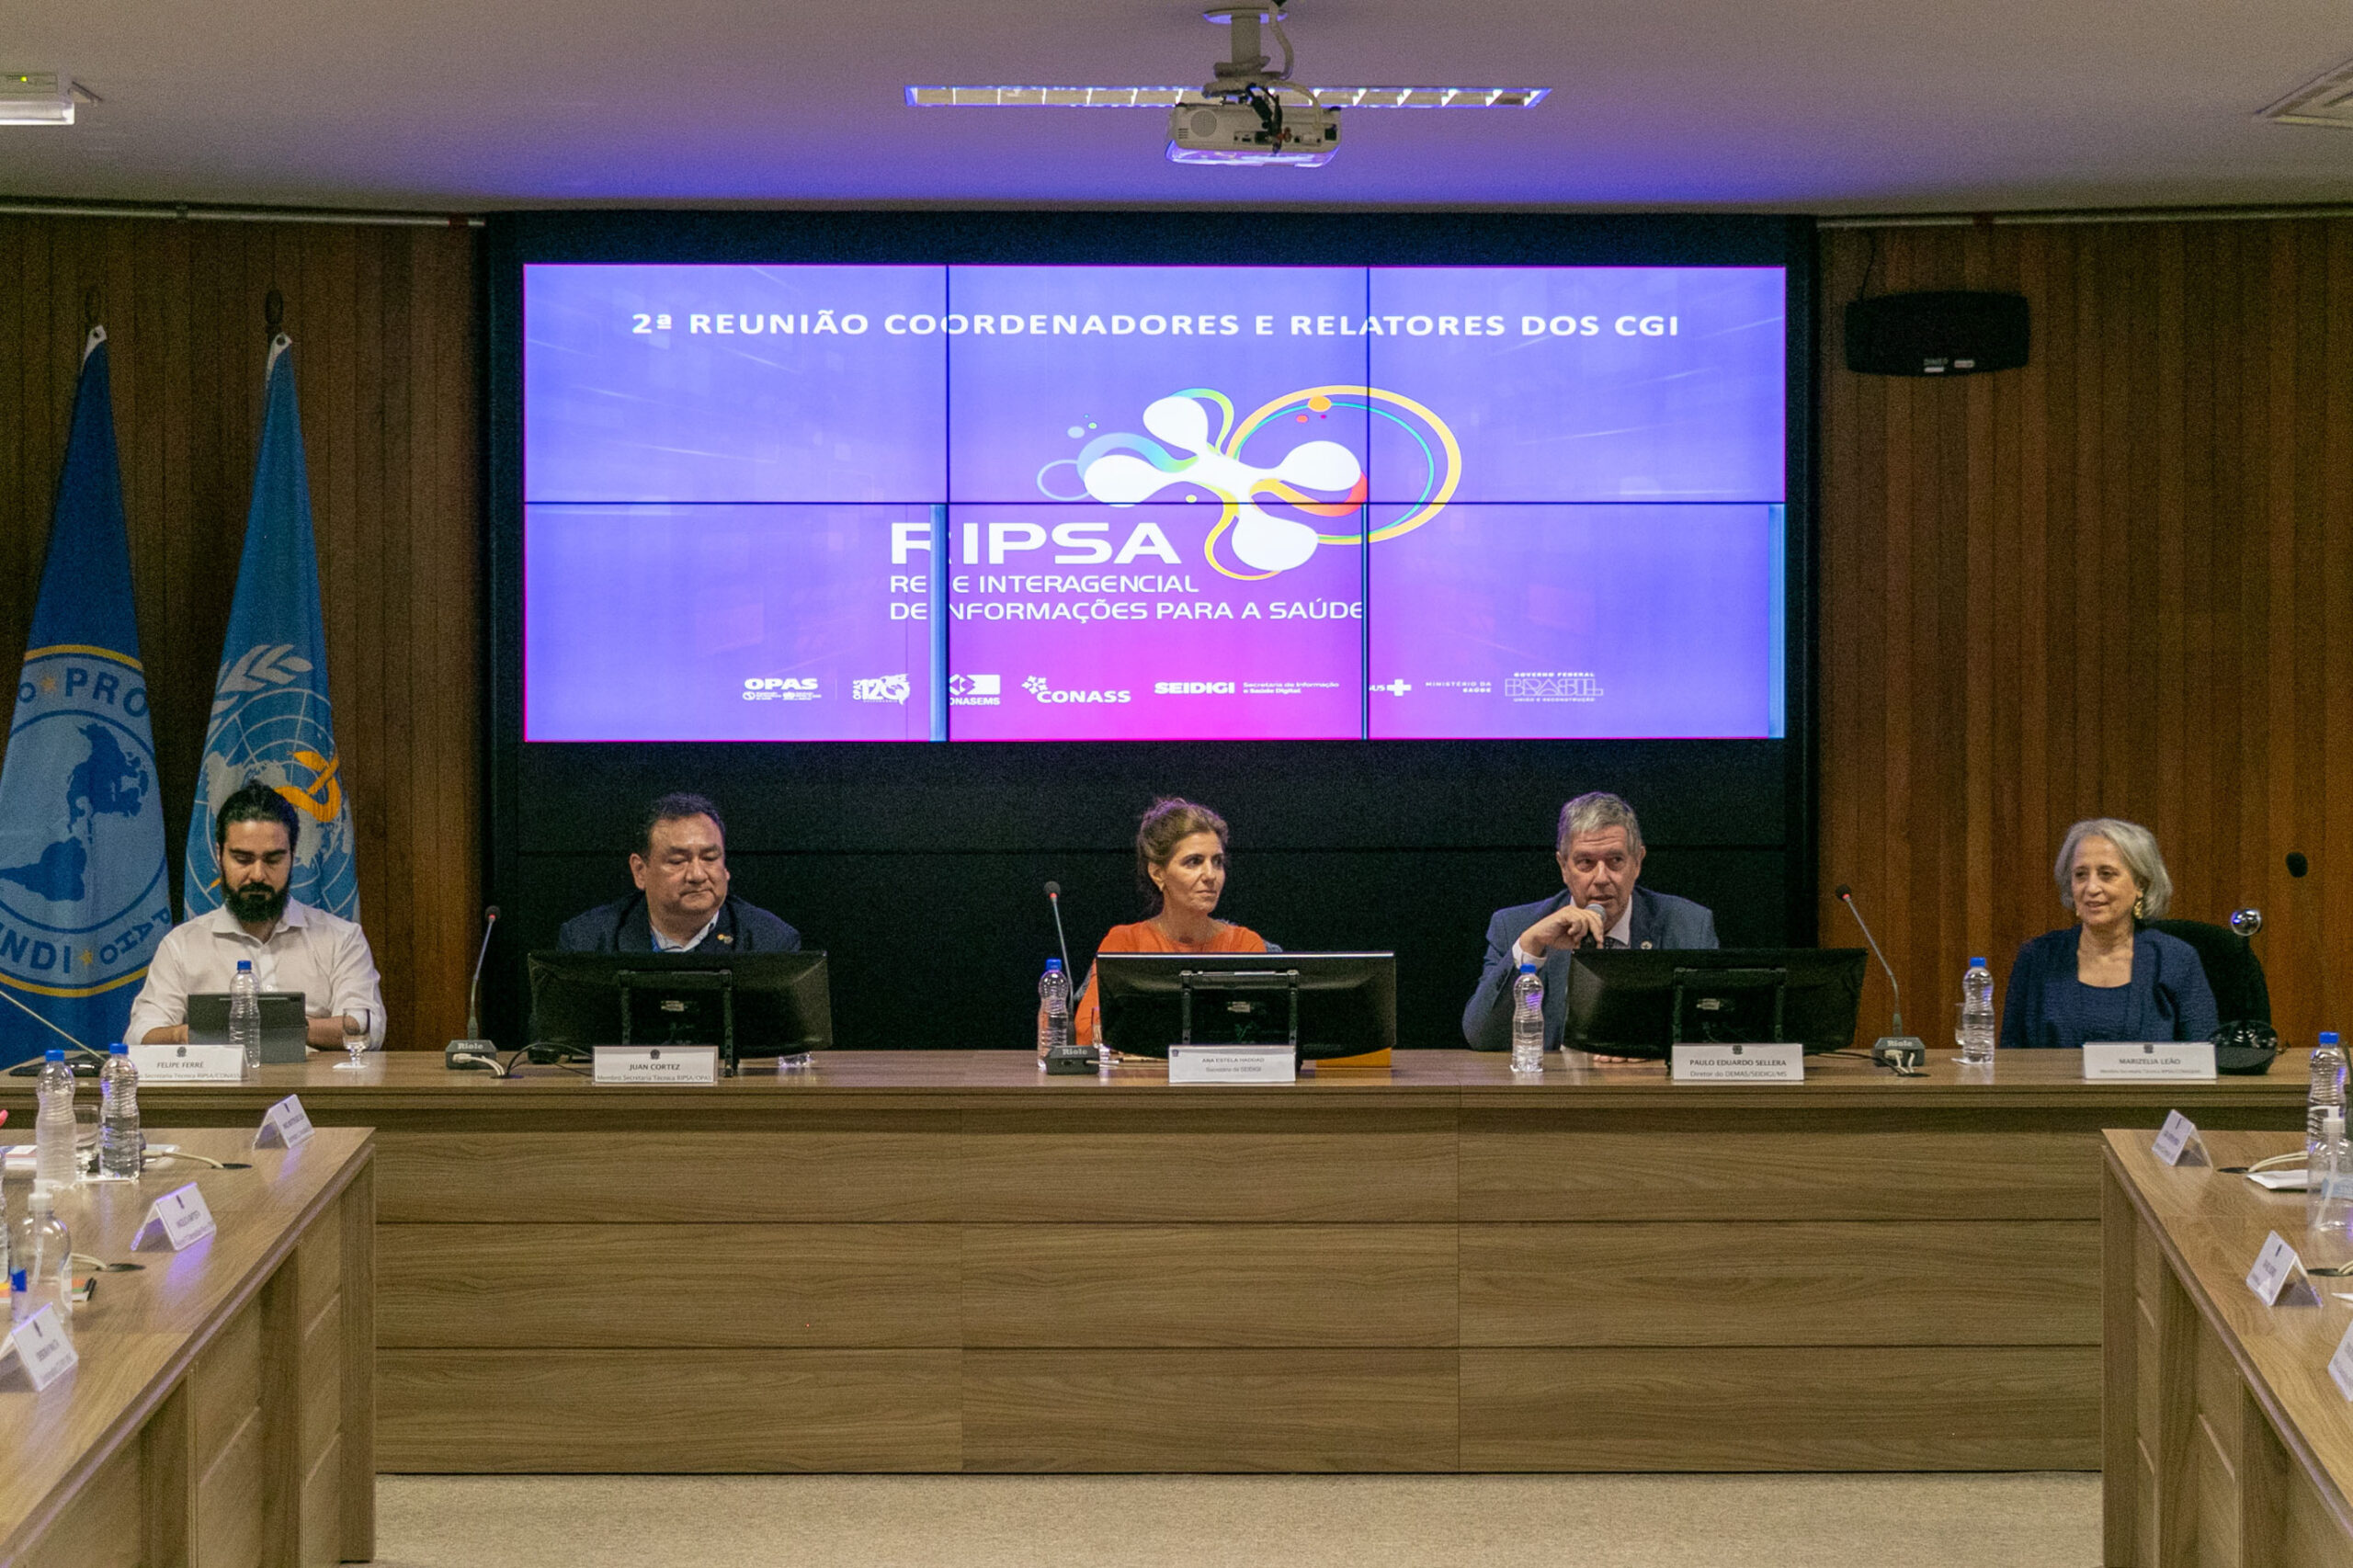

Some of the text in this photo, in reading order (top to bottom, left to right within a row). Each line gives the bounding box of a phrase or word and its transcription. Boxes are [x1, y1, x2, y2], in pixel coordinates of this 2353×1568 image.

[632, 310, 1678, 335] 2ª REUNIÃO COORDENADORES E RELATORES DOS CGI
[891, 575, 1199, 593] REE INTERAGENCIAL
[891, 597, 1363, 624] DE NFORMAÇÕES PARA A SAÚDE
[744, 677, 819, 690] OPAS
[1154, 681, 1235, 694] SEIDIGI
[1505, 678, 1603, 697] BRASIL
[1037, 690, 1131, 703] CONASS
[0, 922, 72, 974] NDI
[156, 1061, 180, 1069] FELIPE
